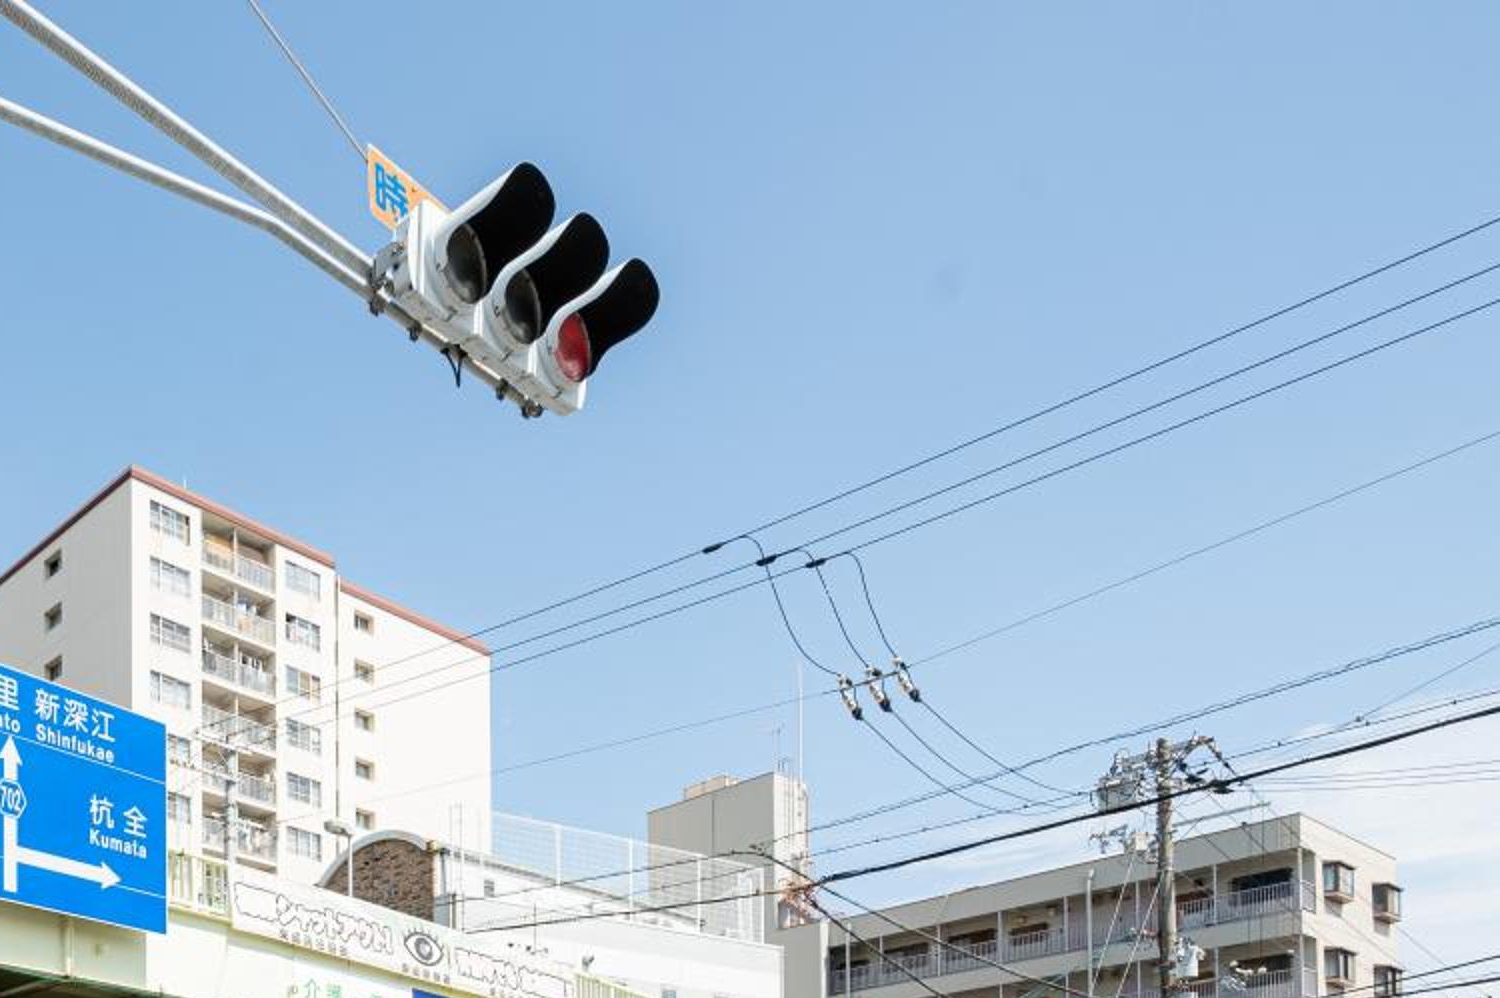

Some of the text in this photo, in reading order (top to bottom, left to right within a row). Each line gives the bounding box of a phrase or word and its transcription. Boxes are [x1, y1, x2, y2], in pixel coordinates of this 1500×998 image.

[34, 688, 116, 743] 新深江
[34, 723, 116, 764] Shinfukae
[0, 784, 23, 811] 702
[88, 793, 149, 839] 杭全
[88, 828, 148, 860] Kumata
